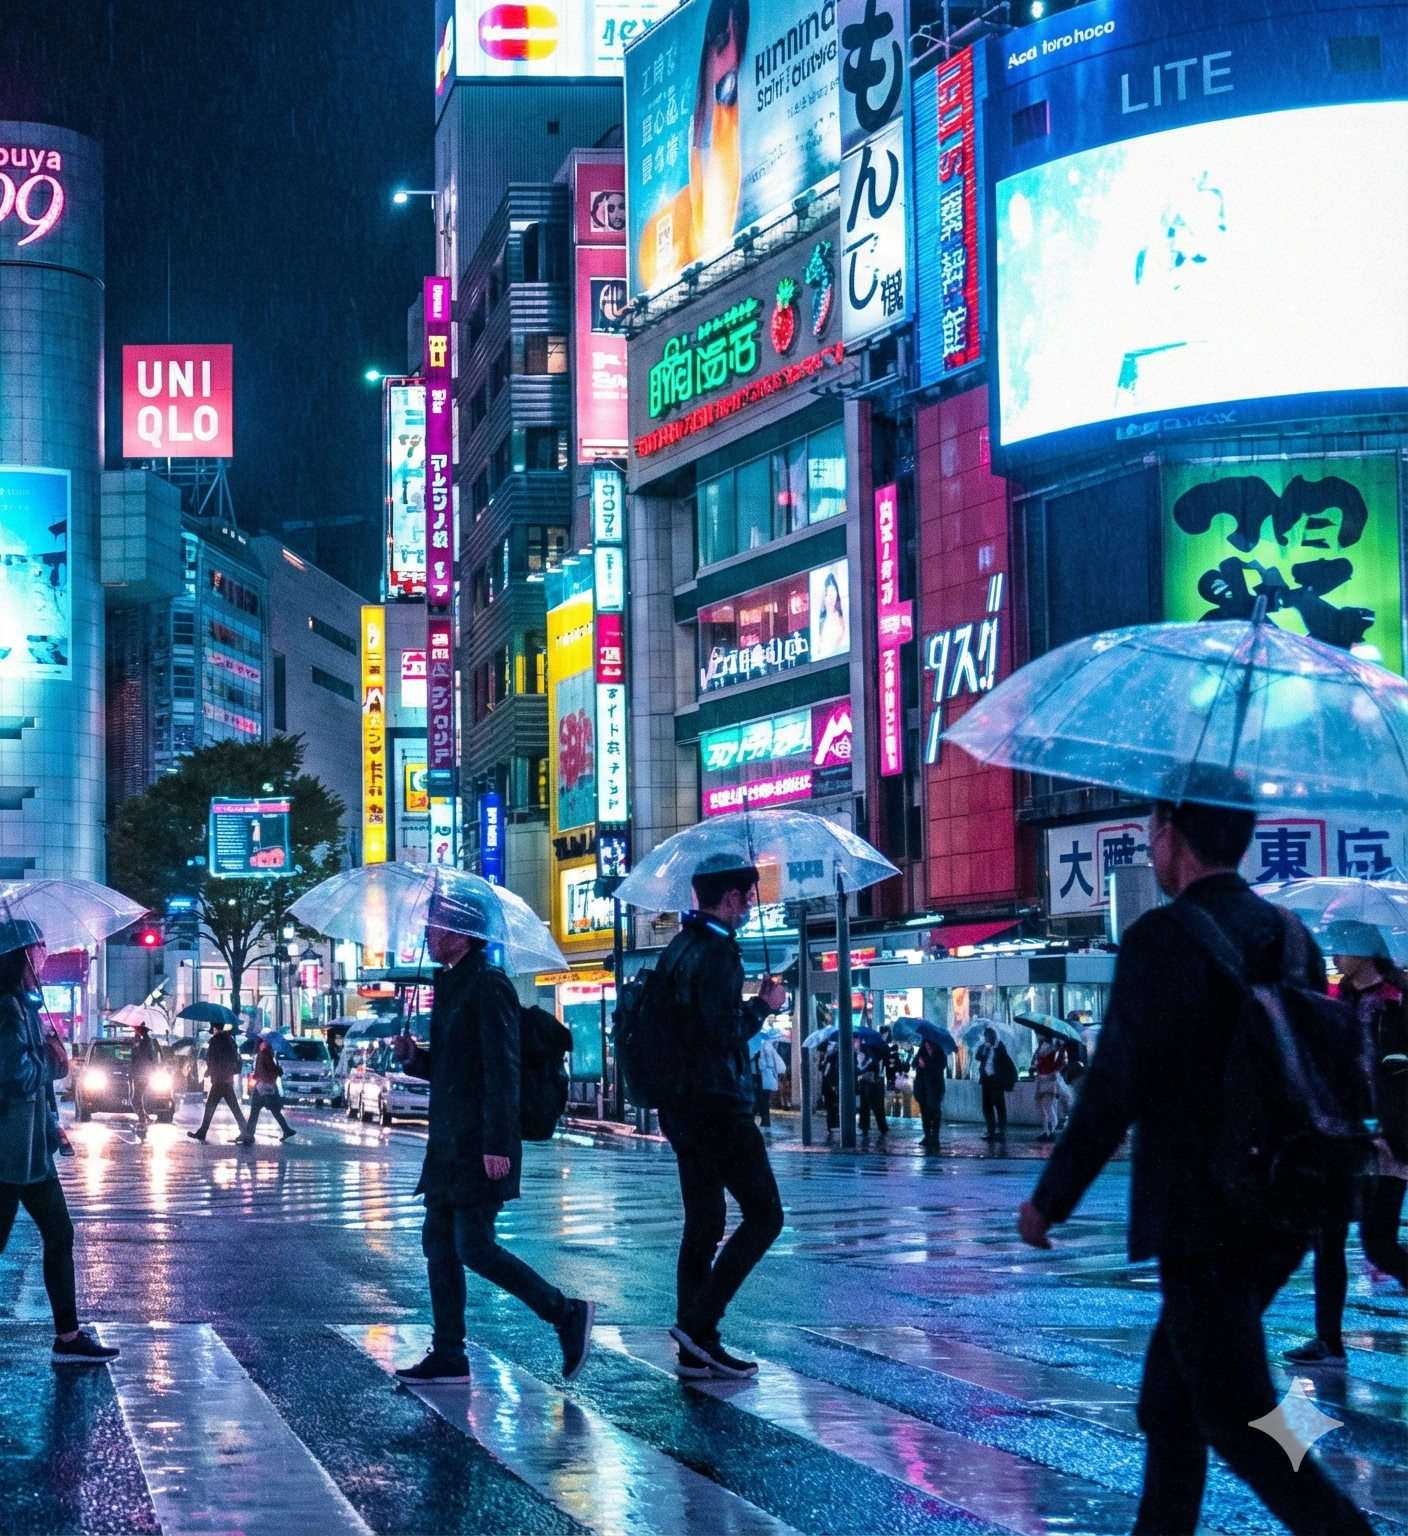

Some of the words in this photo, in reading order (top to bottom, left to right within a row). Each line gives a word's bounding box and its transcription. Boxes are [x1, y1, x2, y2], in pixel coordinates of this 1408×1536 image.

[1121, 51, 1234, 114] LITE
[138, 360, 211, 398] UNI
[138, 404, 219, 448] QLO
